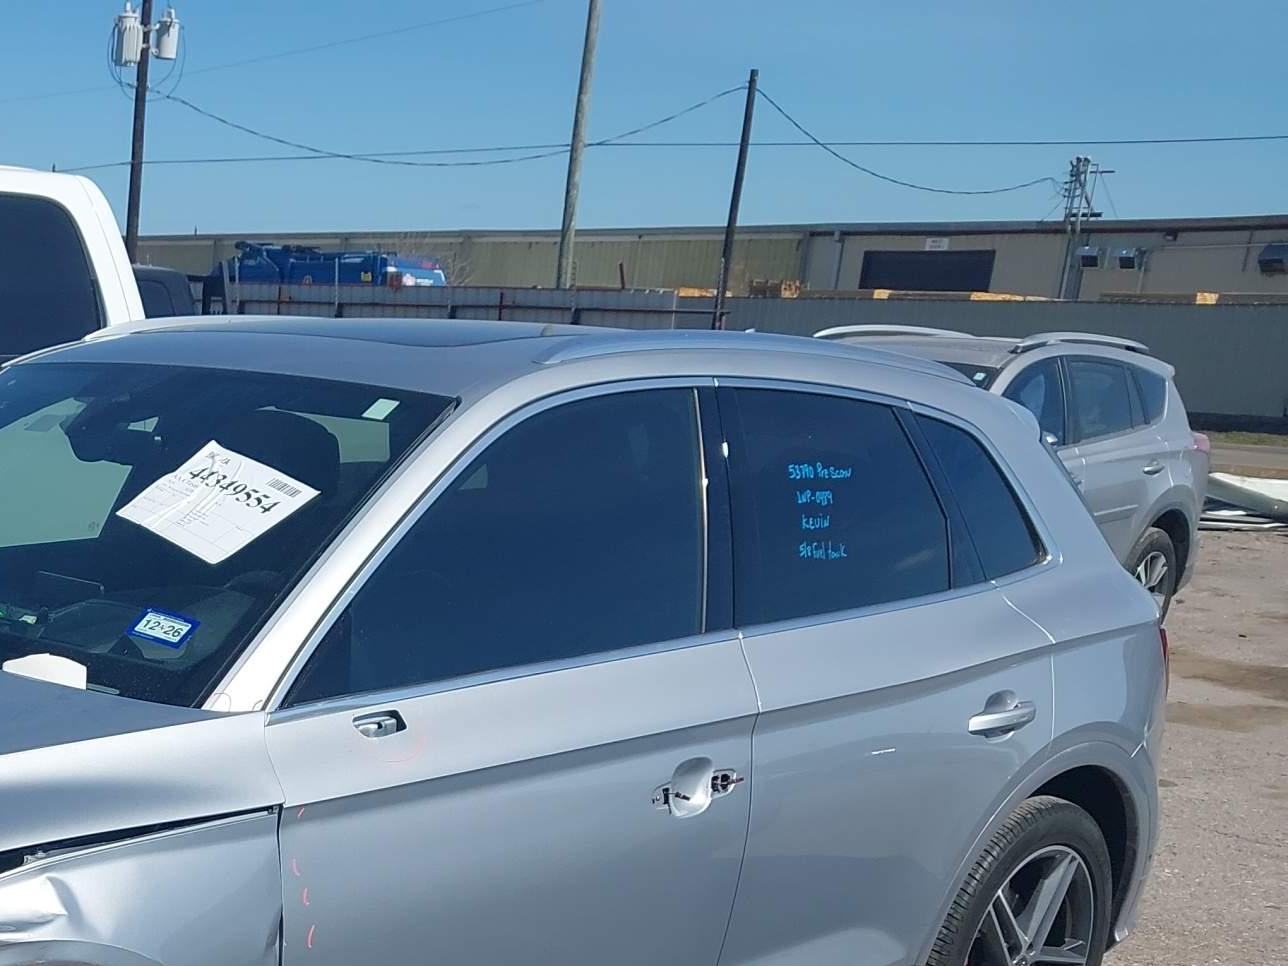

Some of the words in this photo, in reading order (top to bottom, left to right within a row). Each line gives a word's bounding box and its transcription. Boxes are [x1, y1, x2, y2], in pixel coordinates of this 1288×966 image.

[187, 466, 281, 515] 44349554
[143, 619, 161, 631] 12
[162, 625, 184, 638] 26
